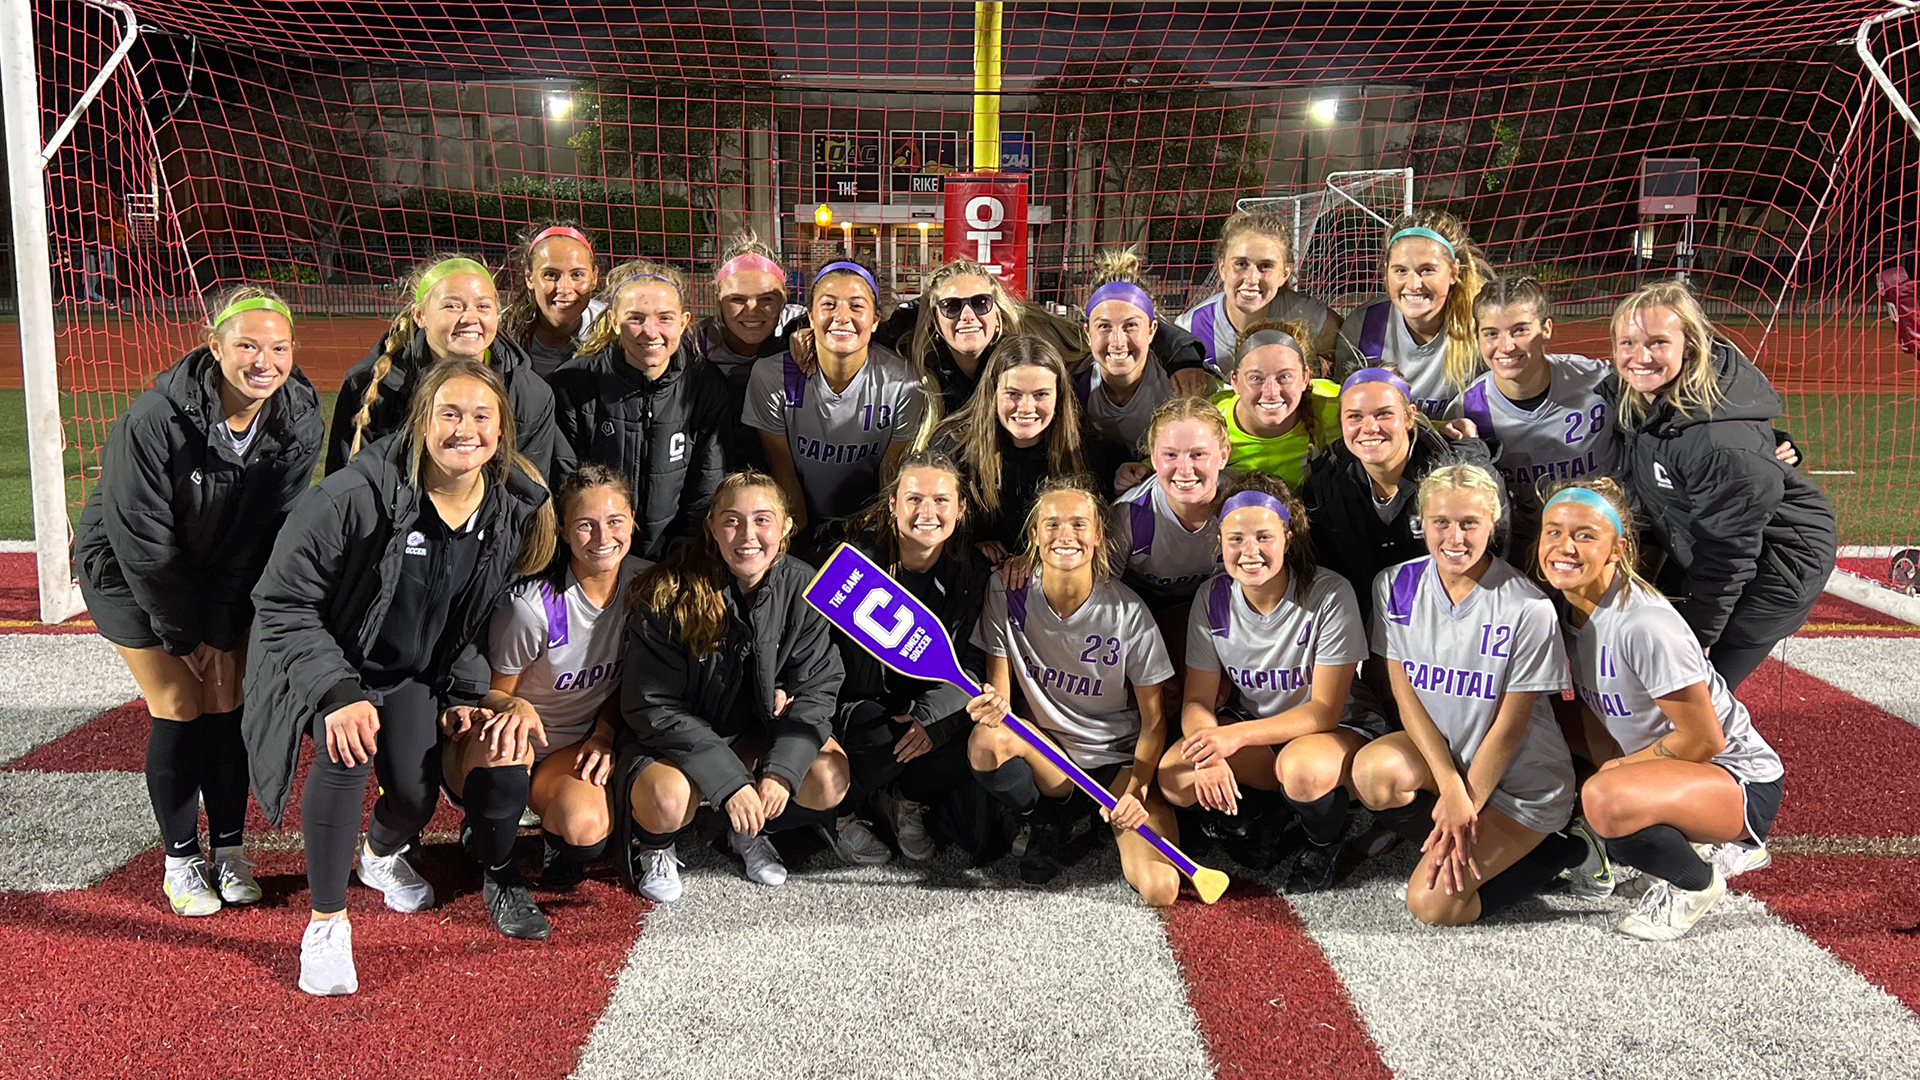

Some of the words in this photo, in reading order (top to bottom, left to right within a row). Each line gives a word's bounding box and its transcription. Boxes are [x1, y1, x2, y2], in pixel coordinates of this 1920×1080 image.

[828, 144, 878, 163] OAC
[837, 181, 858, 196] THE
[913, 178, 939, 192] RIKE
[964, 195, 1005, 275] OT
[863, 404, 892, 432] 13
[1564, 403, 1606, 445] 28
[669, 431, 685, 457] C
[797, 435, 880, 464] CAPITAL
[1500, 450, 1599, 484] CAPITAL
[828, 589, 847, 609] THE
[841, 568, 864, 594] GAME
[853, 587, 915, 650] C
[898, 626, 926, 658] WOMEN'S
[908, 634, 933, 663] SOCCER
[1080, 634, 1121, 667] 23
[1296, 620, 1313, 650] 4
[1480, 623, 1512, 659] 12
[1402, 659, 1497, 700] CAPITAL
